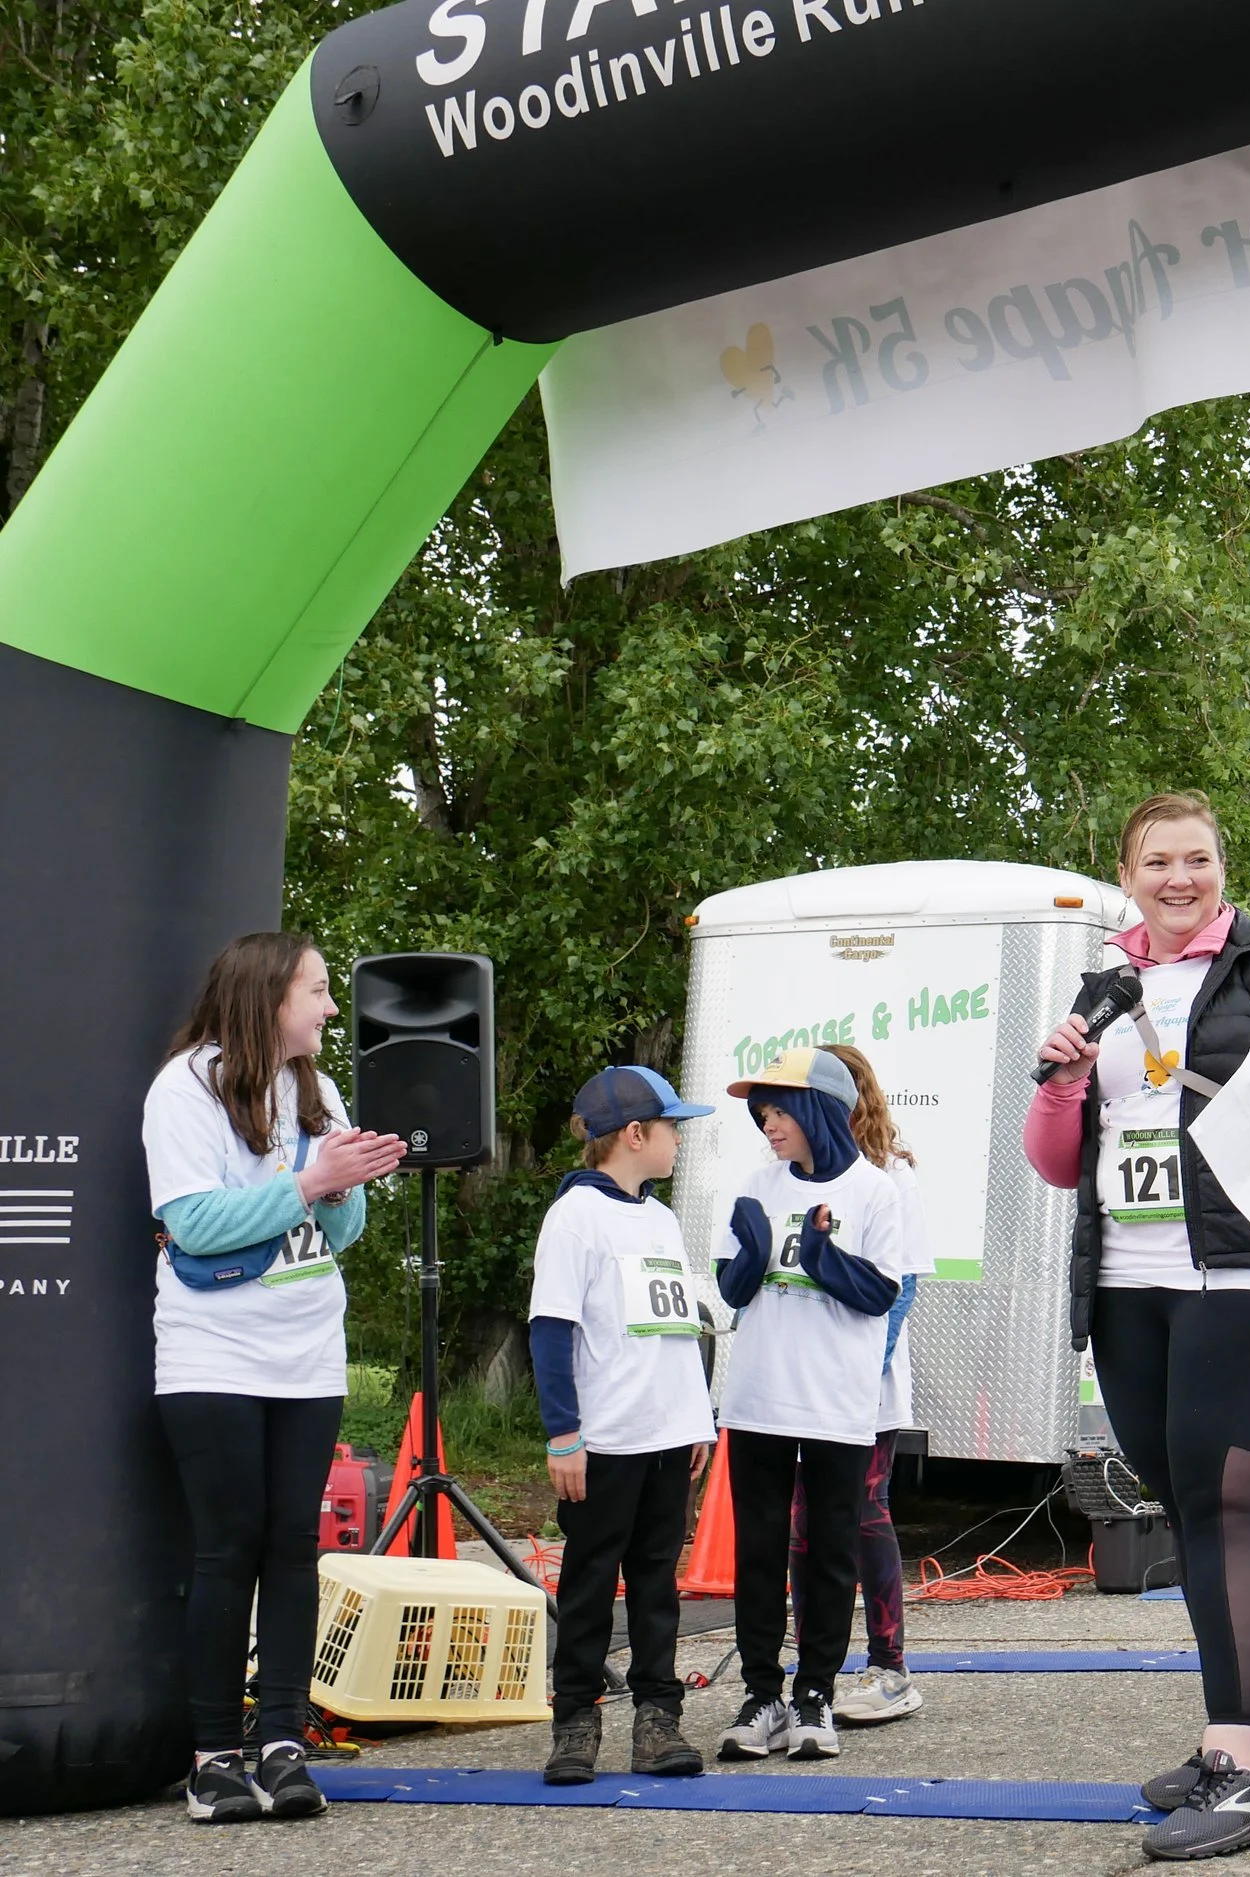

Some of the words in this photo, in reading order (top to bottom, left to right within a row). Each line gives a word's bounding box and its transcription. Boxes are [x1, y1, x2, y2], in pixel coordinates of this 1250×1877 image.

[425, 4, 776, 157] Woodinville
[830, 933, 895, 948] Continental
[844, 948, 878, 962] Cargo
[872, 1002, 892, 1041] &
[908, 983, 990, 1031] HARE
[886, 1089, 940, 1106] utions
[1118, 1154, 1180, 1203] 121
[648, 1279, 688, 1318] 68
